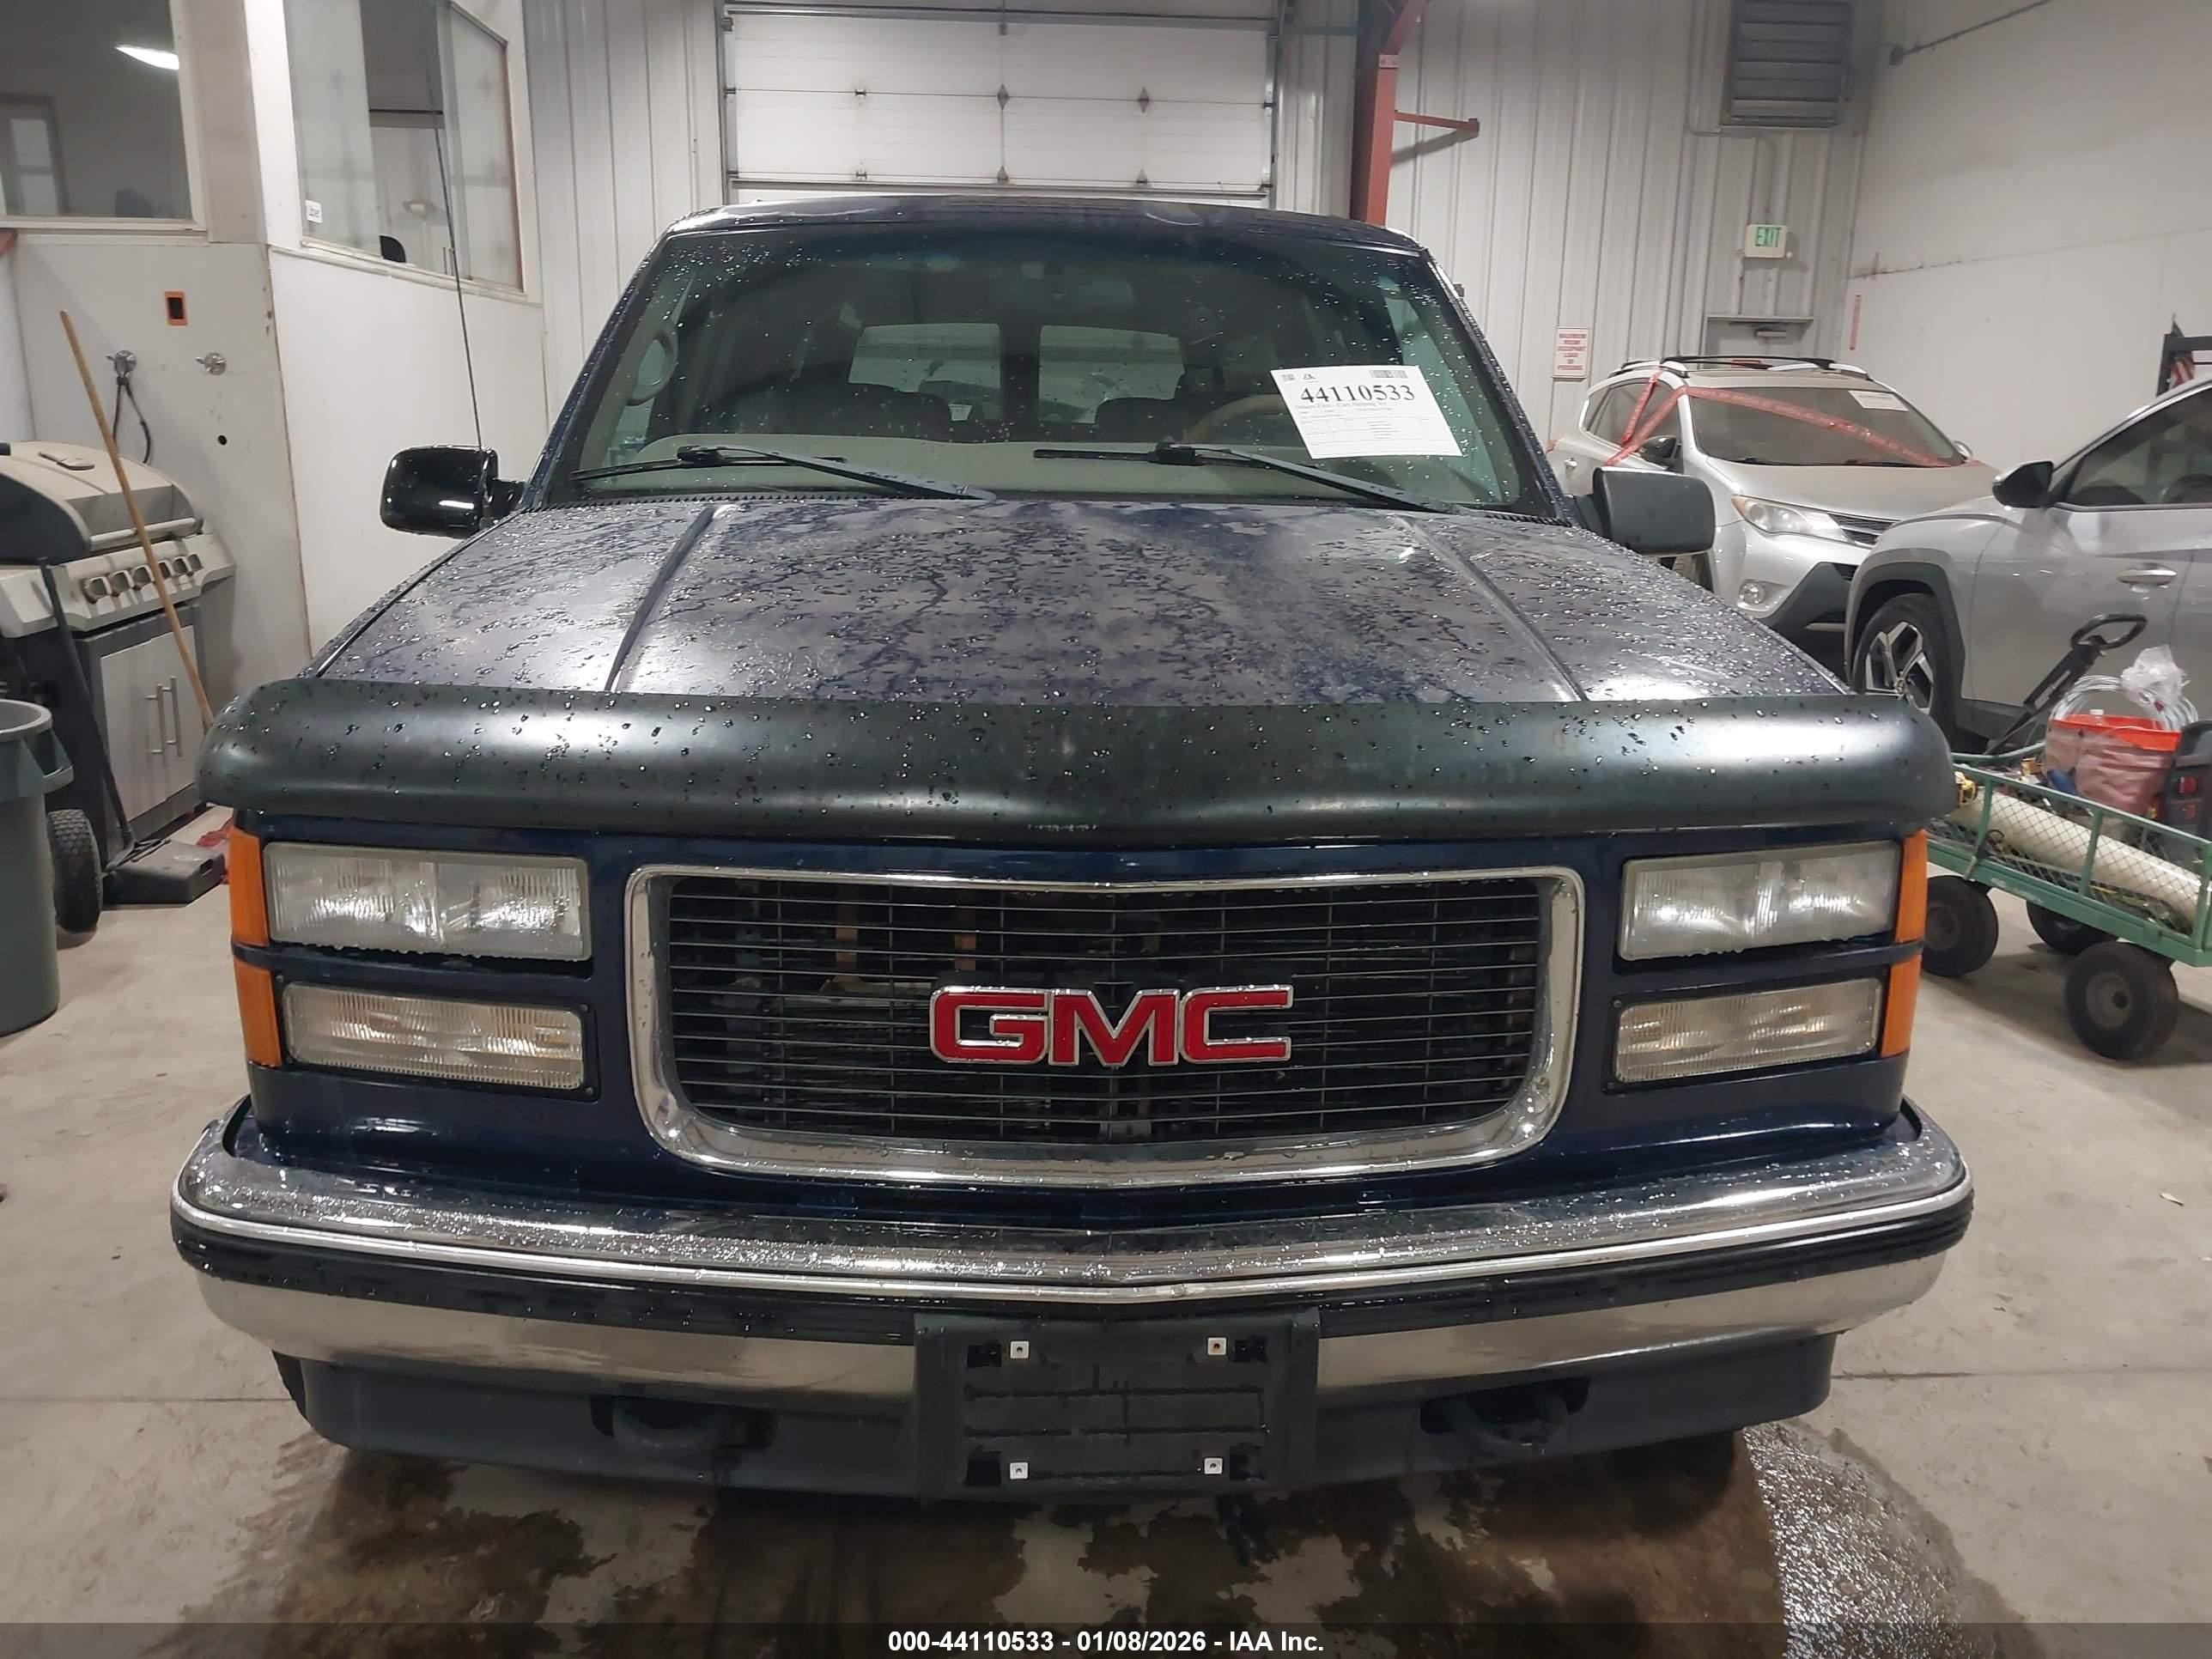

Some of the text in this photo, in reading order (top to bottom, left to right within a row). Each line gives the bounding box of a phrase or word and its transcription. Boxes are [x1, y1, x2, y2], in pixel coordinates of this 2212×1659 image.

[1755, 227, 1782, 247] EXIT
[1300, 384, 1415, 404] 44110533
[929, 984, 1294, 1068] GMC
